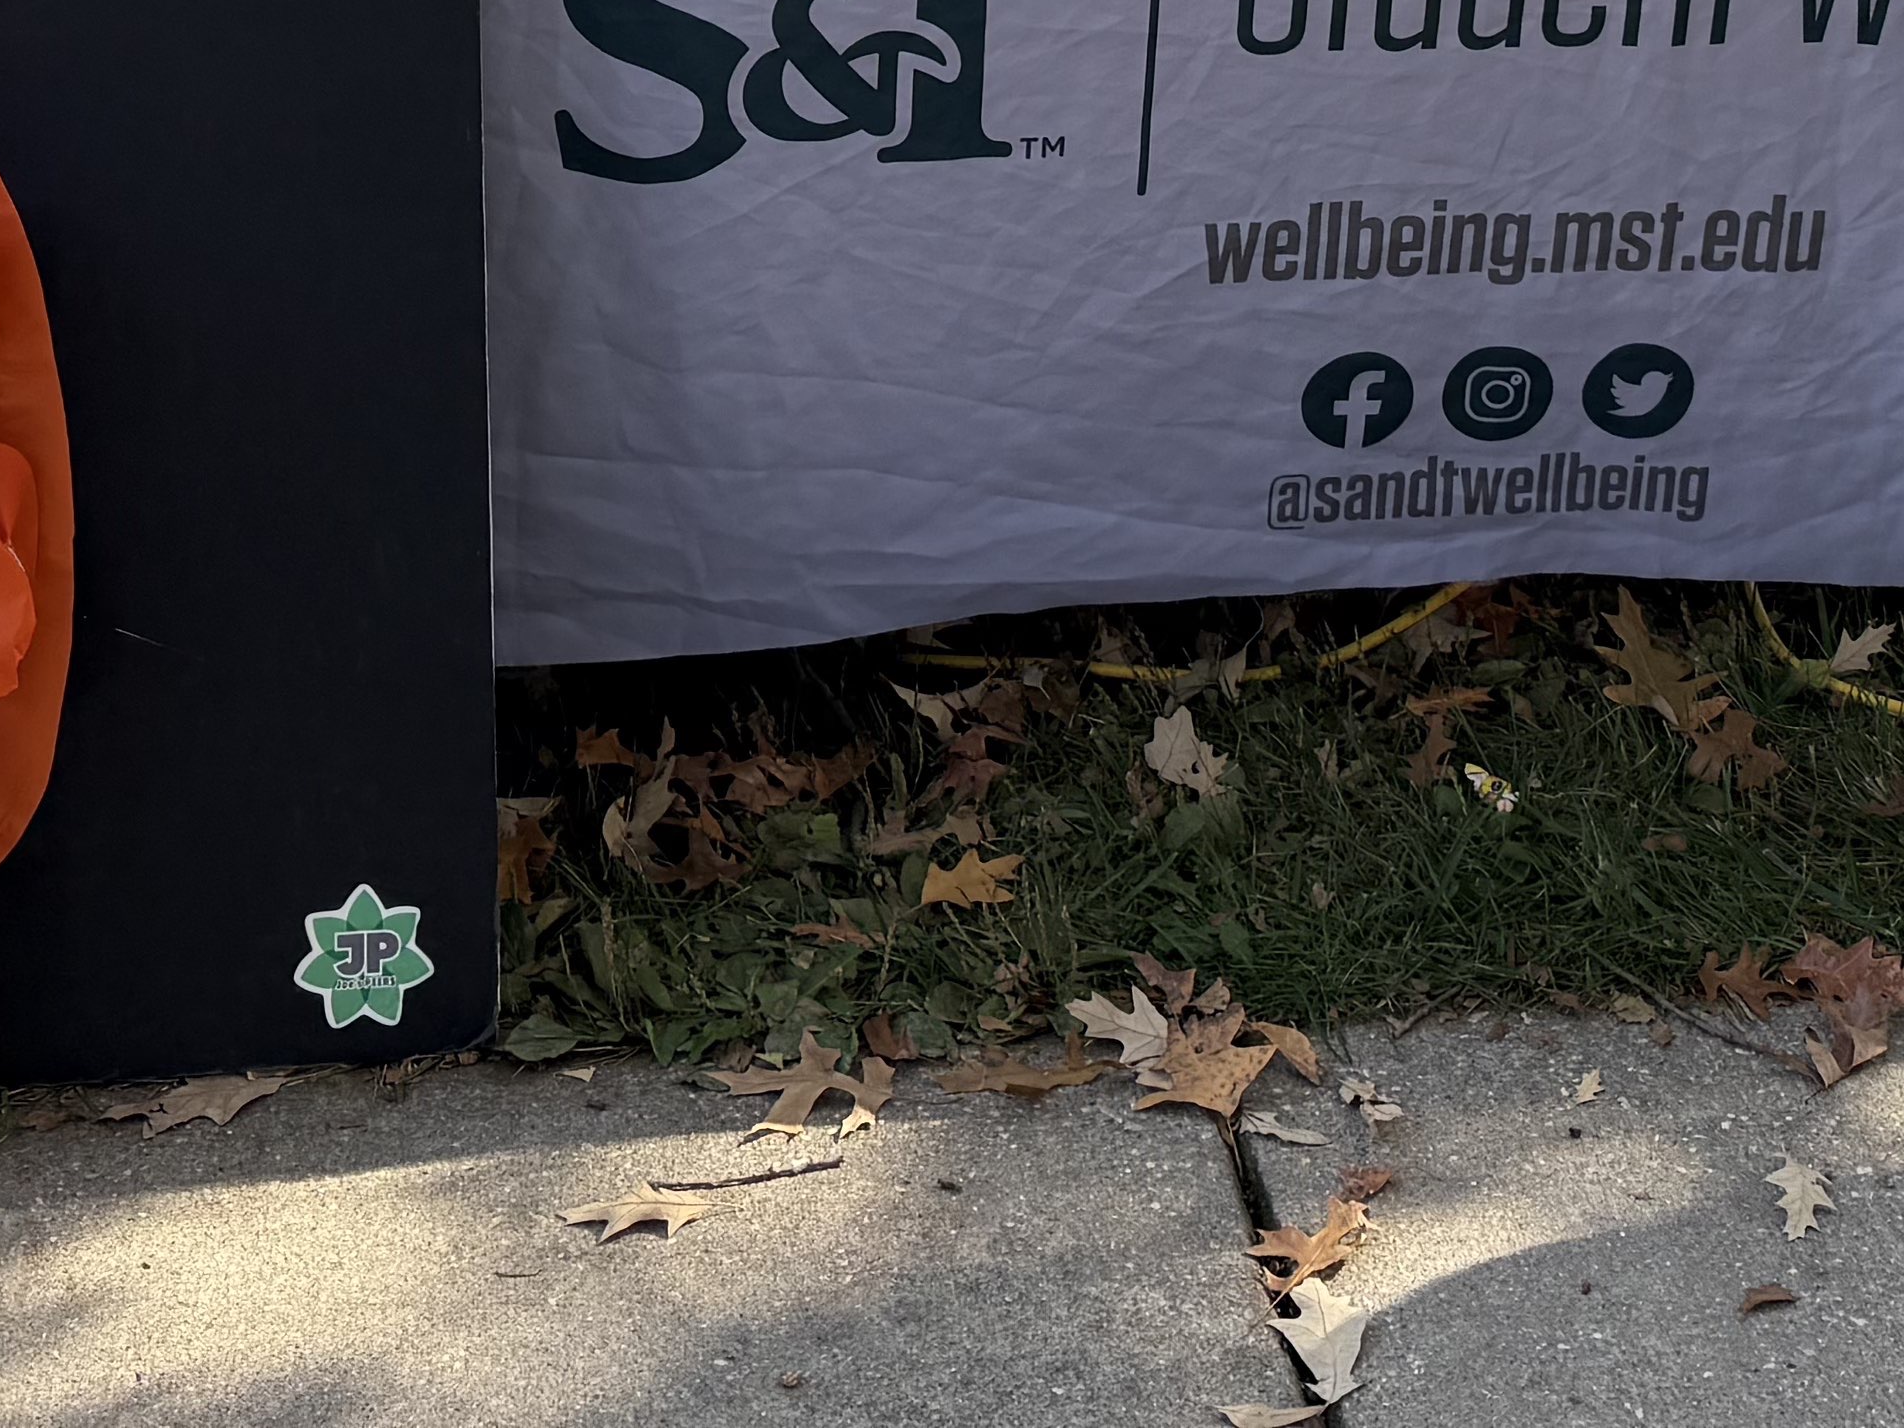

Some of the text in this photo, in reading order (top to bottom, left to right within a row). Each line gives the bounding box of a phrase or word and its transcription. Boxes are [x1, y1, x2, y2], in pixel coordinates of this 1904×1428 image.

[1204, 193, 1827, 286] wellbeing.mst.edu
[1267, 452, 1711, 531] @sandtwellbeing
[333, 930, 402, 979] JP
